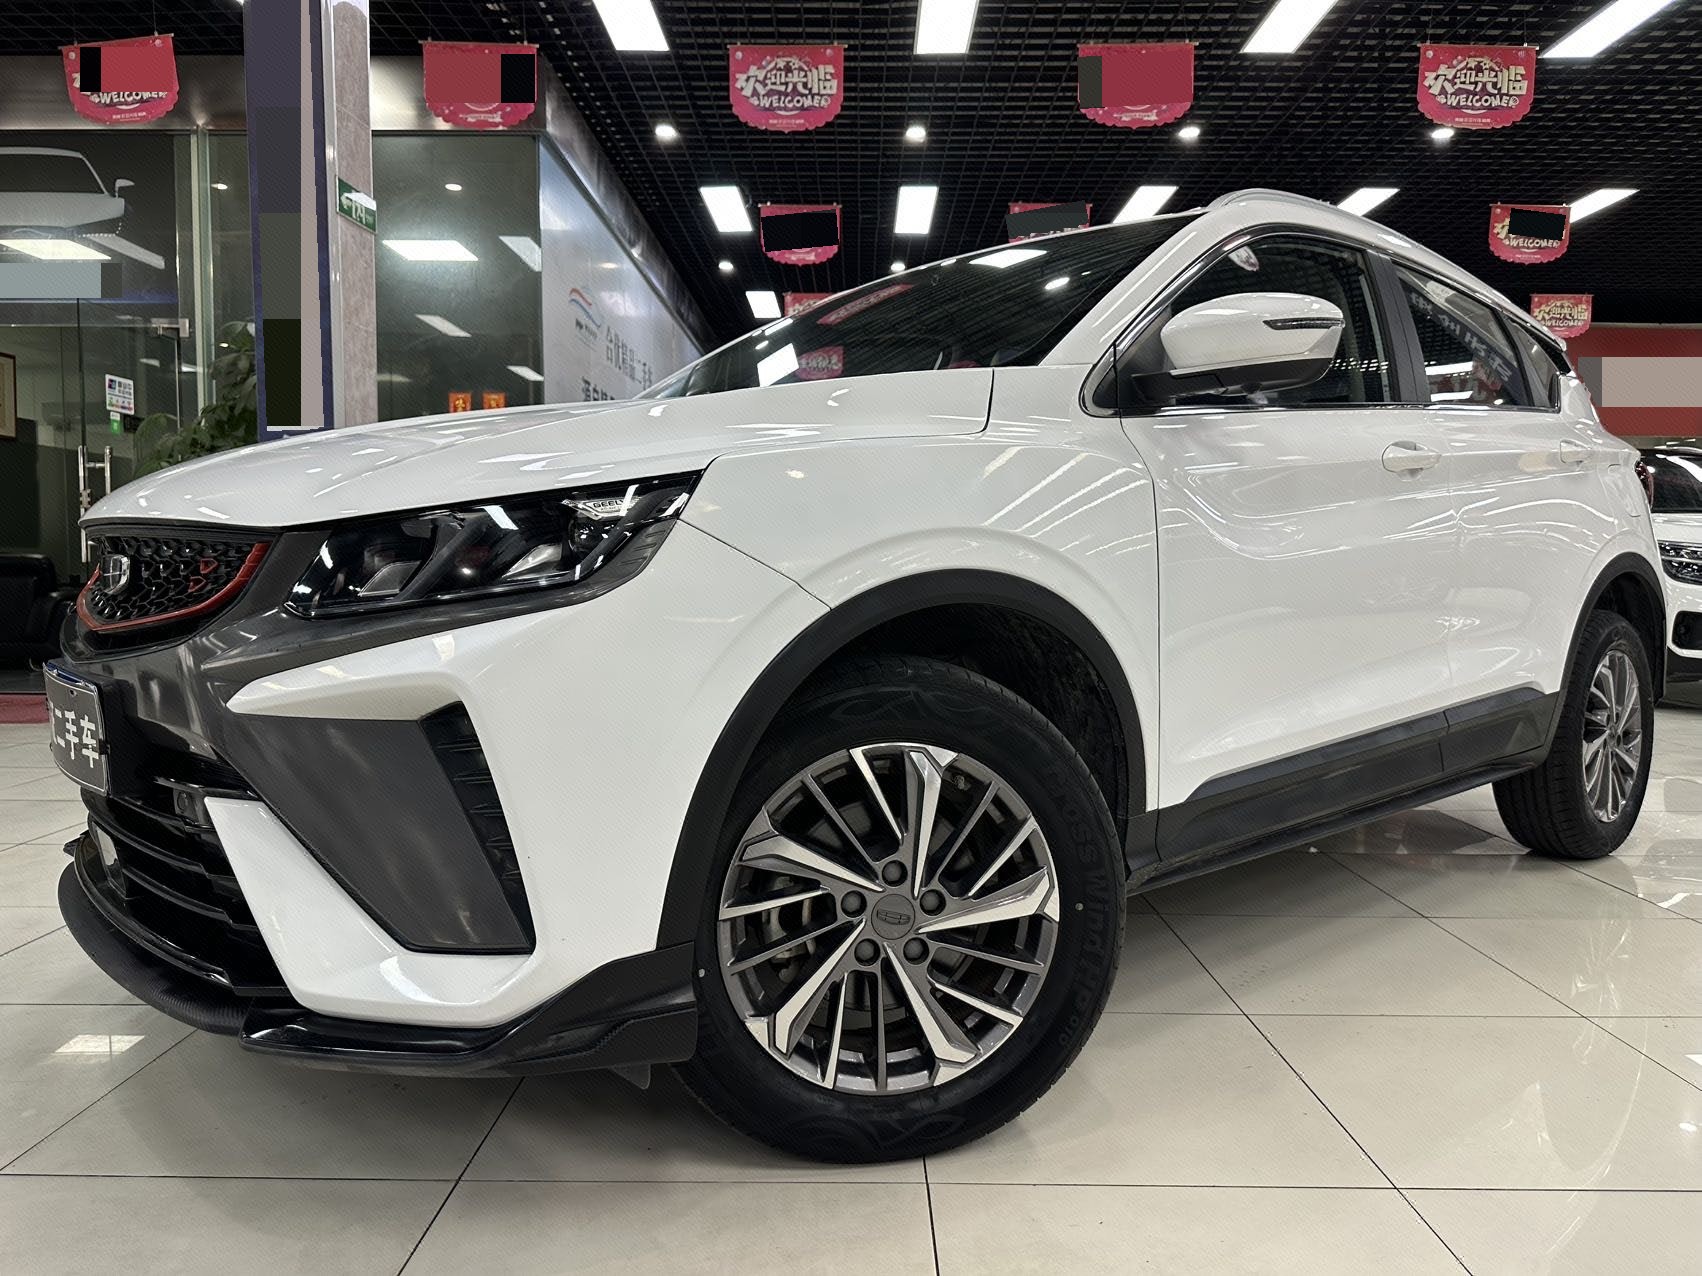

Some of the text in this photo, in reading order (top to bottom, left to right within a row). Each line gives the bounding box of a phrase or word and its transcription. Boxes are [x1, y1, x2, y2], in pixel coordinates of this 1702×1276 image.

[735, 64, 838, 98] 欢迎光临
[1423, 64, 1528, 96] 欢迎光临
[1533, 303, 1588, 320] 欢迎光临
[49, 700, 99, 768] 二手车
